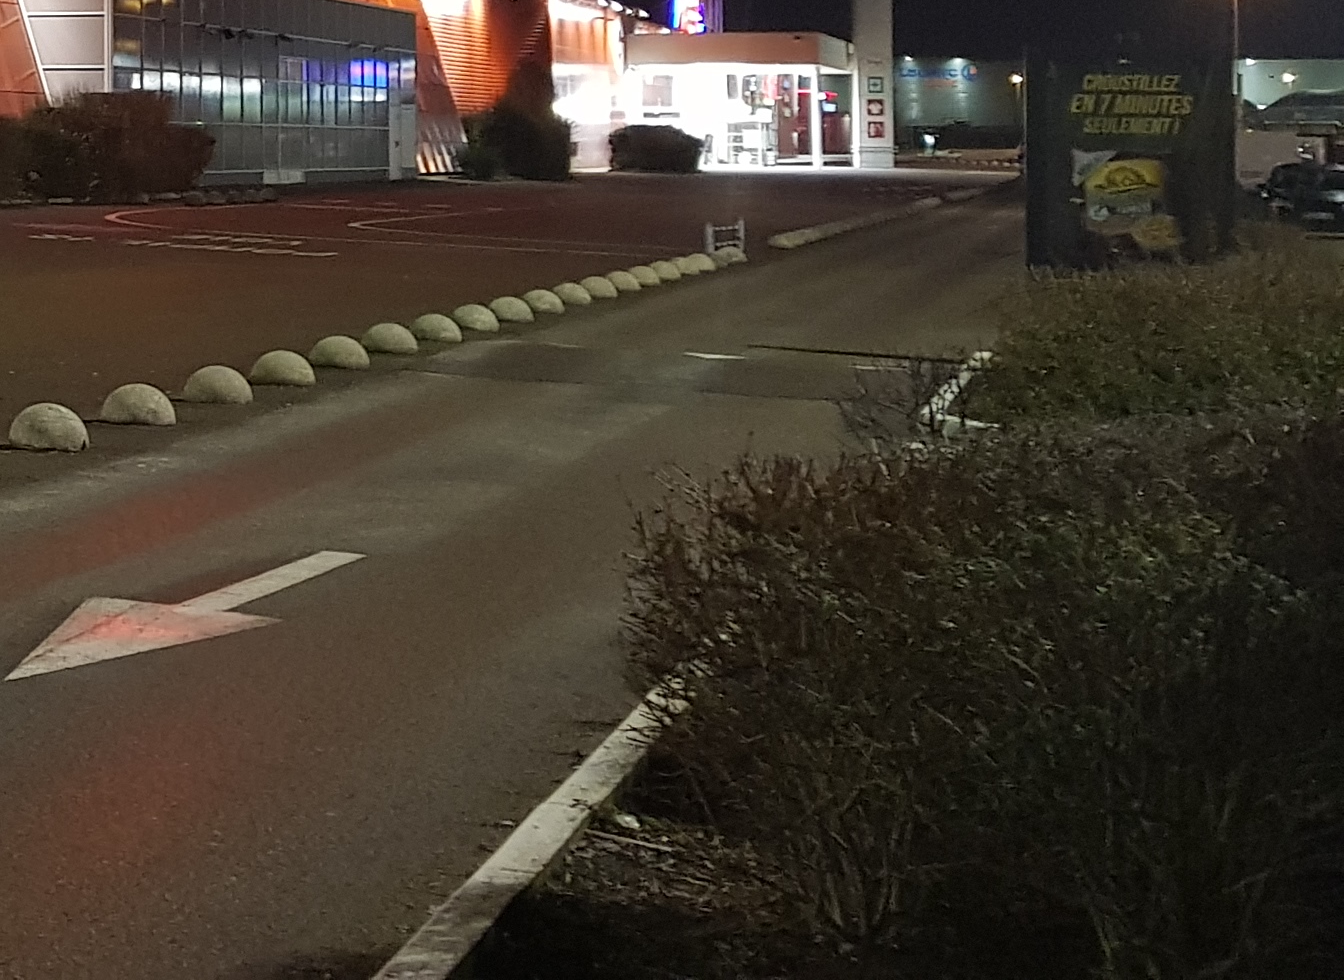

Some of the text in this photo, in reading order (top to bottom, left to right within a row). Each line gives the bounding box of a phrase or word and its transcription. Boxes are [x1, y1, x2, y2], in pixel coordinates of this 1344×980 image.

[1070, 93, 1194, 115] EN 7 MINUTES
